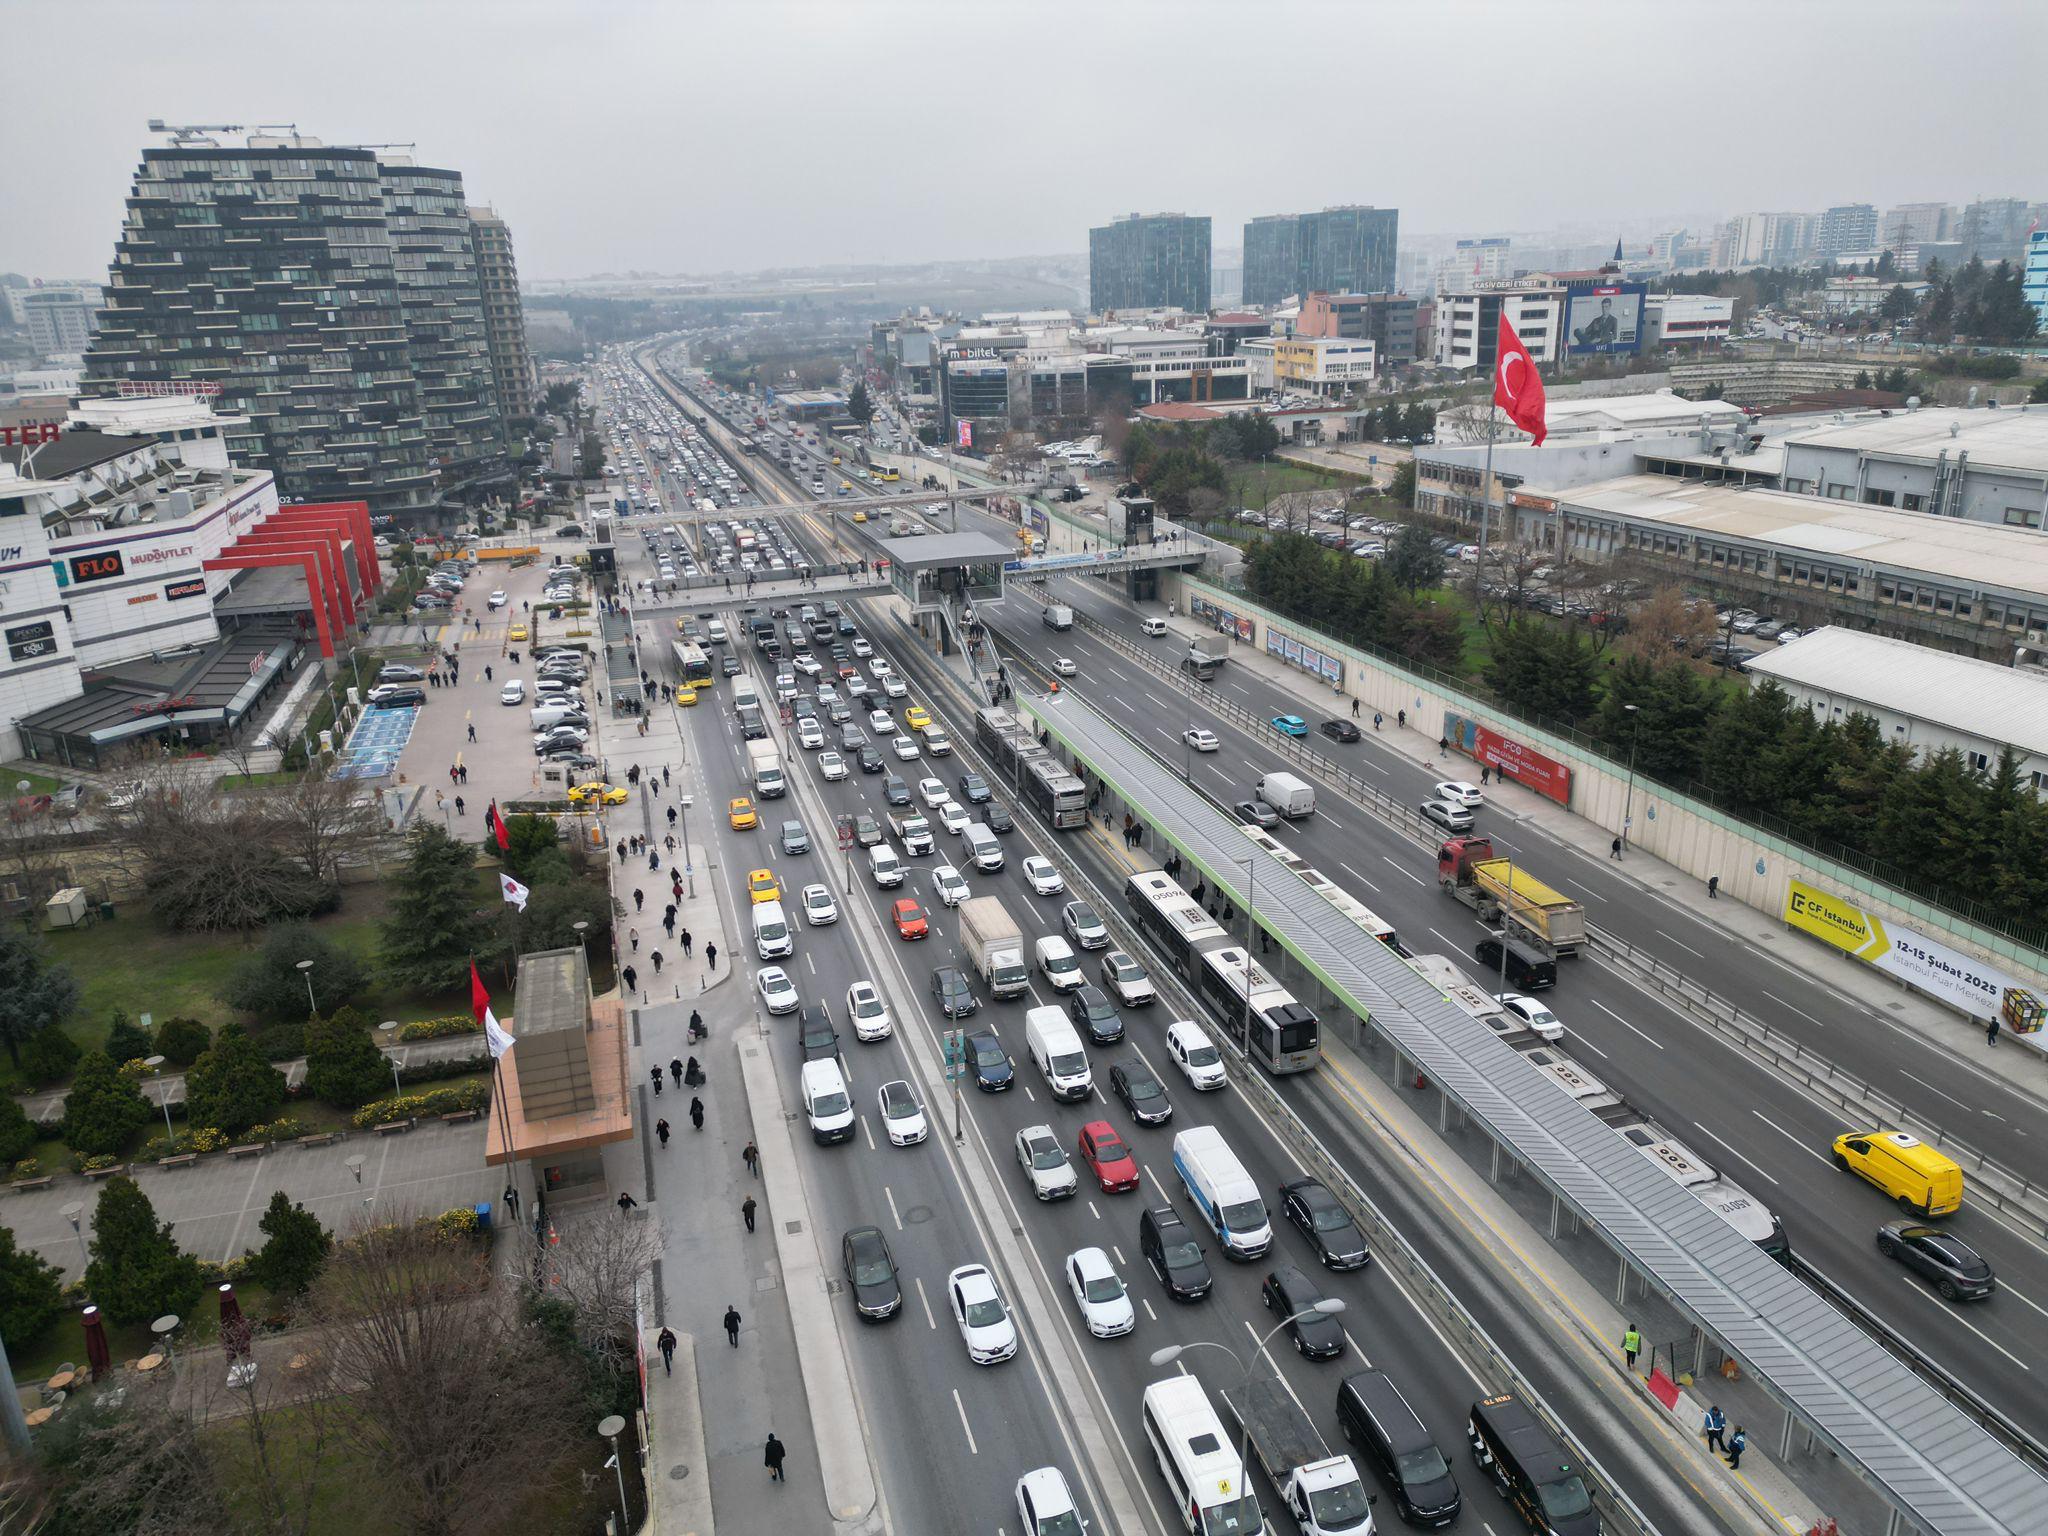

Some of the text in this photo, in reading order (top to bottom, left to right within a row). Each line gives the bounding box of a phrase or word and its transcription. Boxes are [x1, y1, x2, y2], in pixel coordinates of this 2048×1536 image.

[77, 557, 118, 577] FLO
[1808, 901, 1823, 913] CF
[1897, 940, 1997, 995] 12-15 Şubat 2025
[1932, 971, 1954, 989] Fuar
[1956, 983, 1995, 1009] Merkezi
